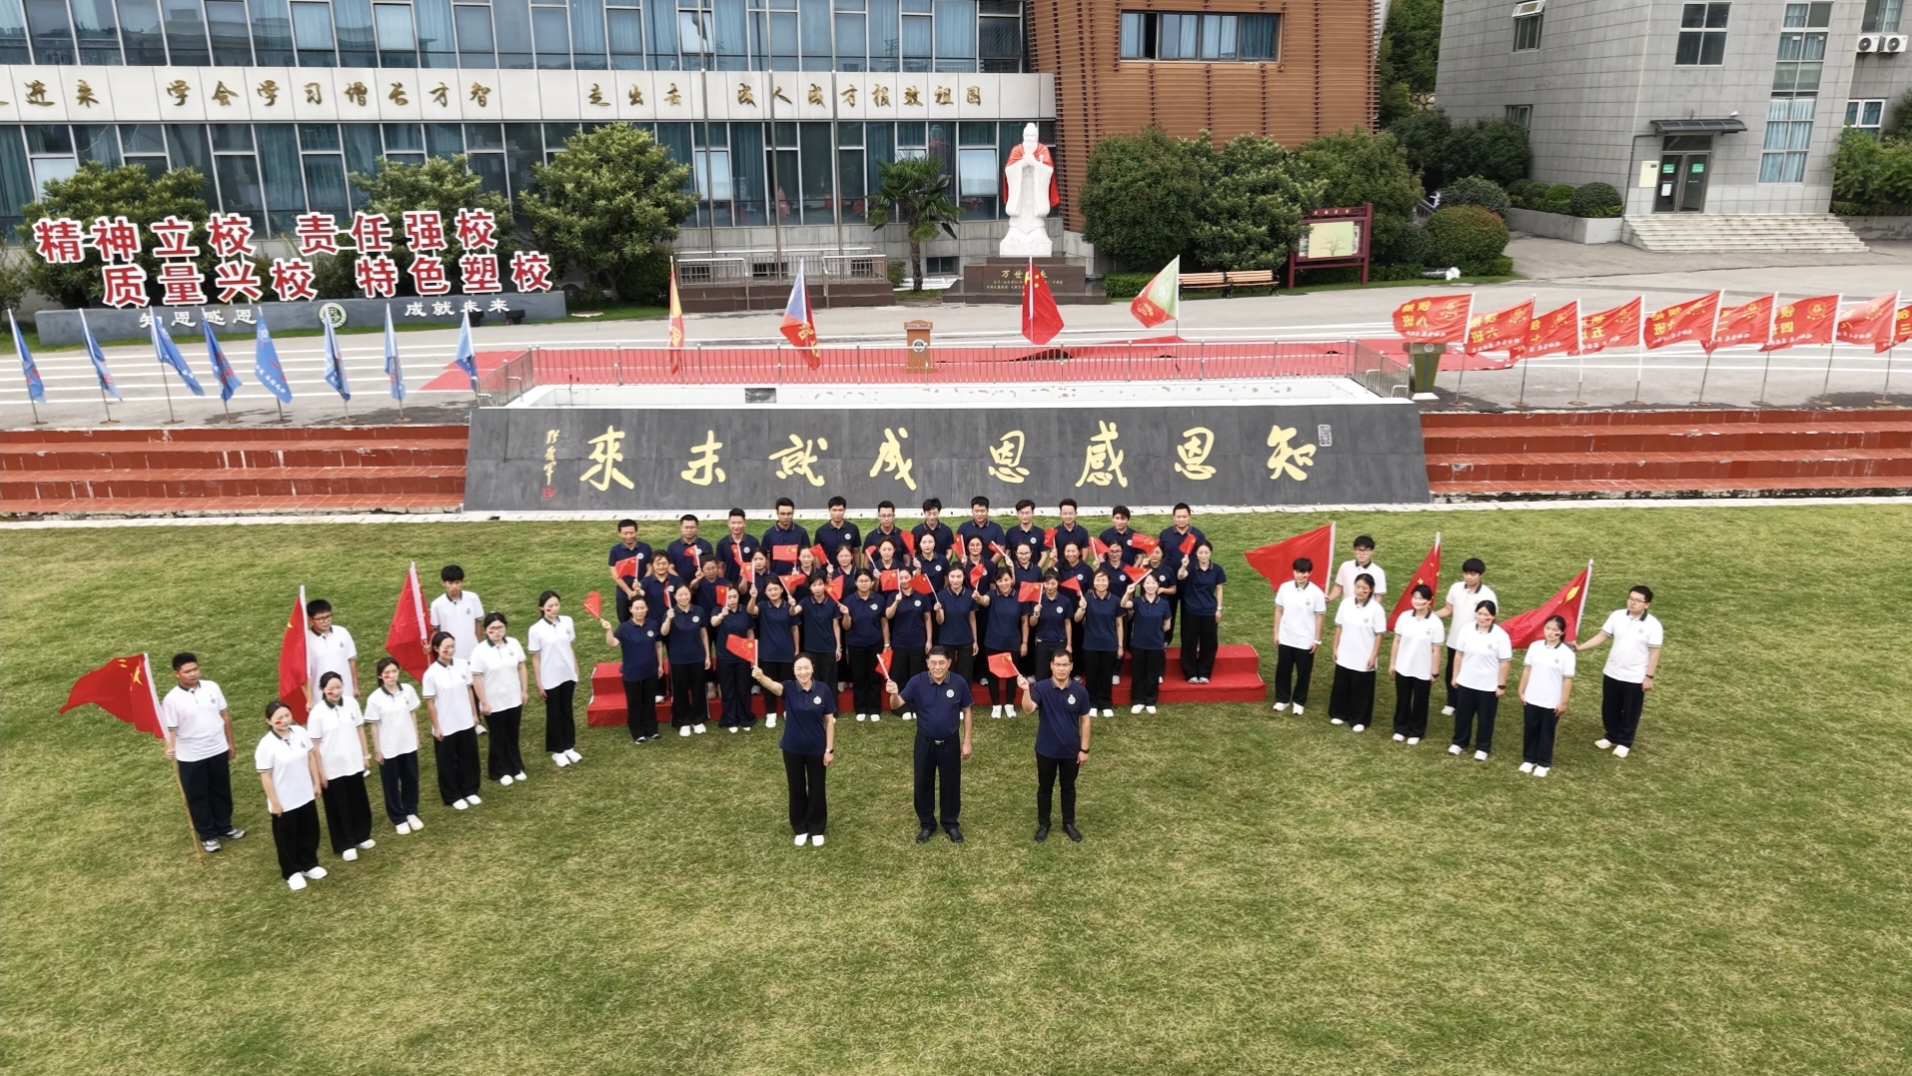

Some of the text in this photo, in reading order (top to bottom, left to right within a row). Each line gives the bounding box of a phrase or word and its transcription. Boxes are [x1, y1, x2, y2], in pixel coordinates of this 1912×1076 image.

[0, 79, 99, 108] 进来
[588, 82, 683, 108] 走出去
[34, 207, 497, 264] 精神立校 责任强校
[101, 251, 552, 308] 质量兴校 特色塑校
